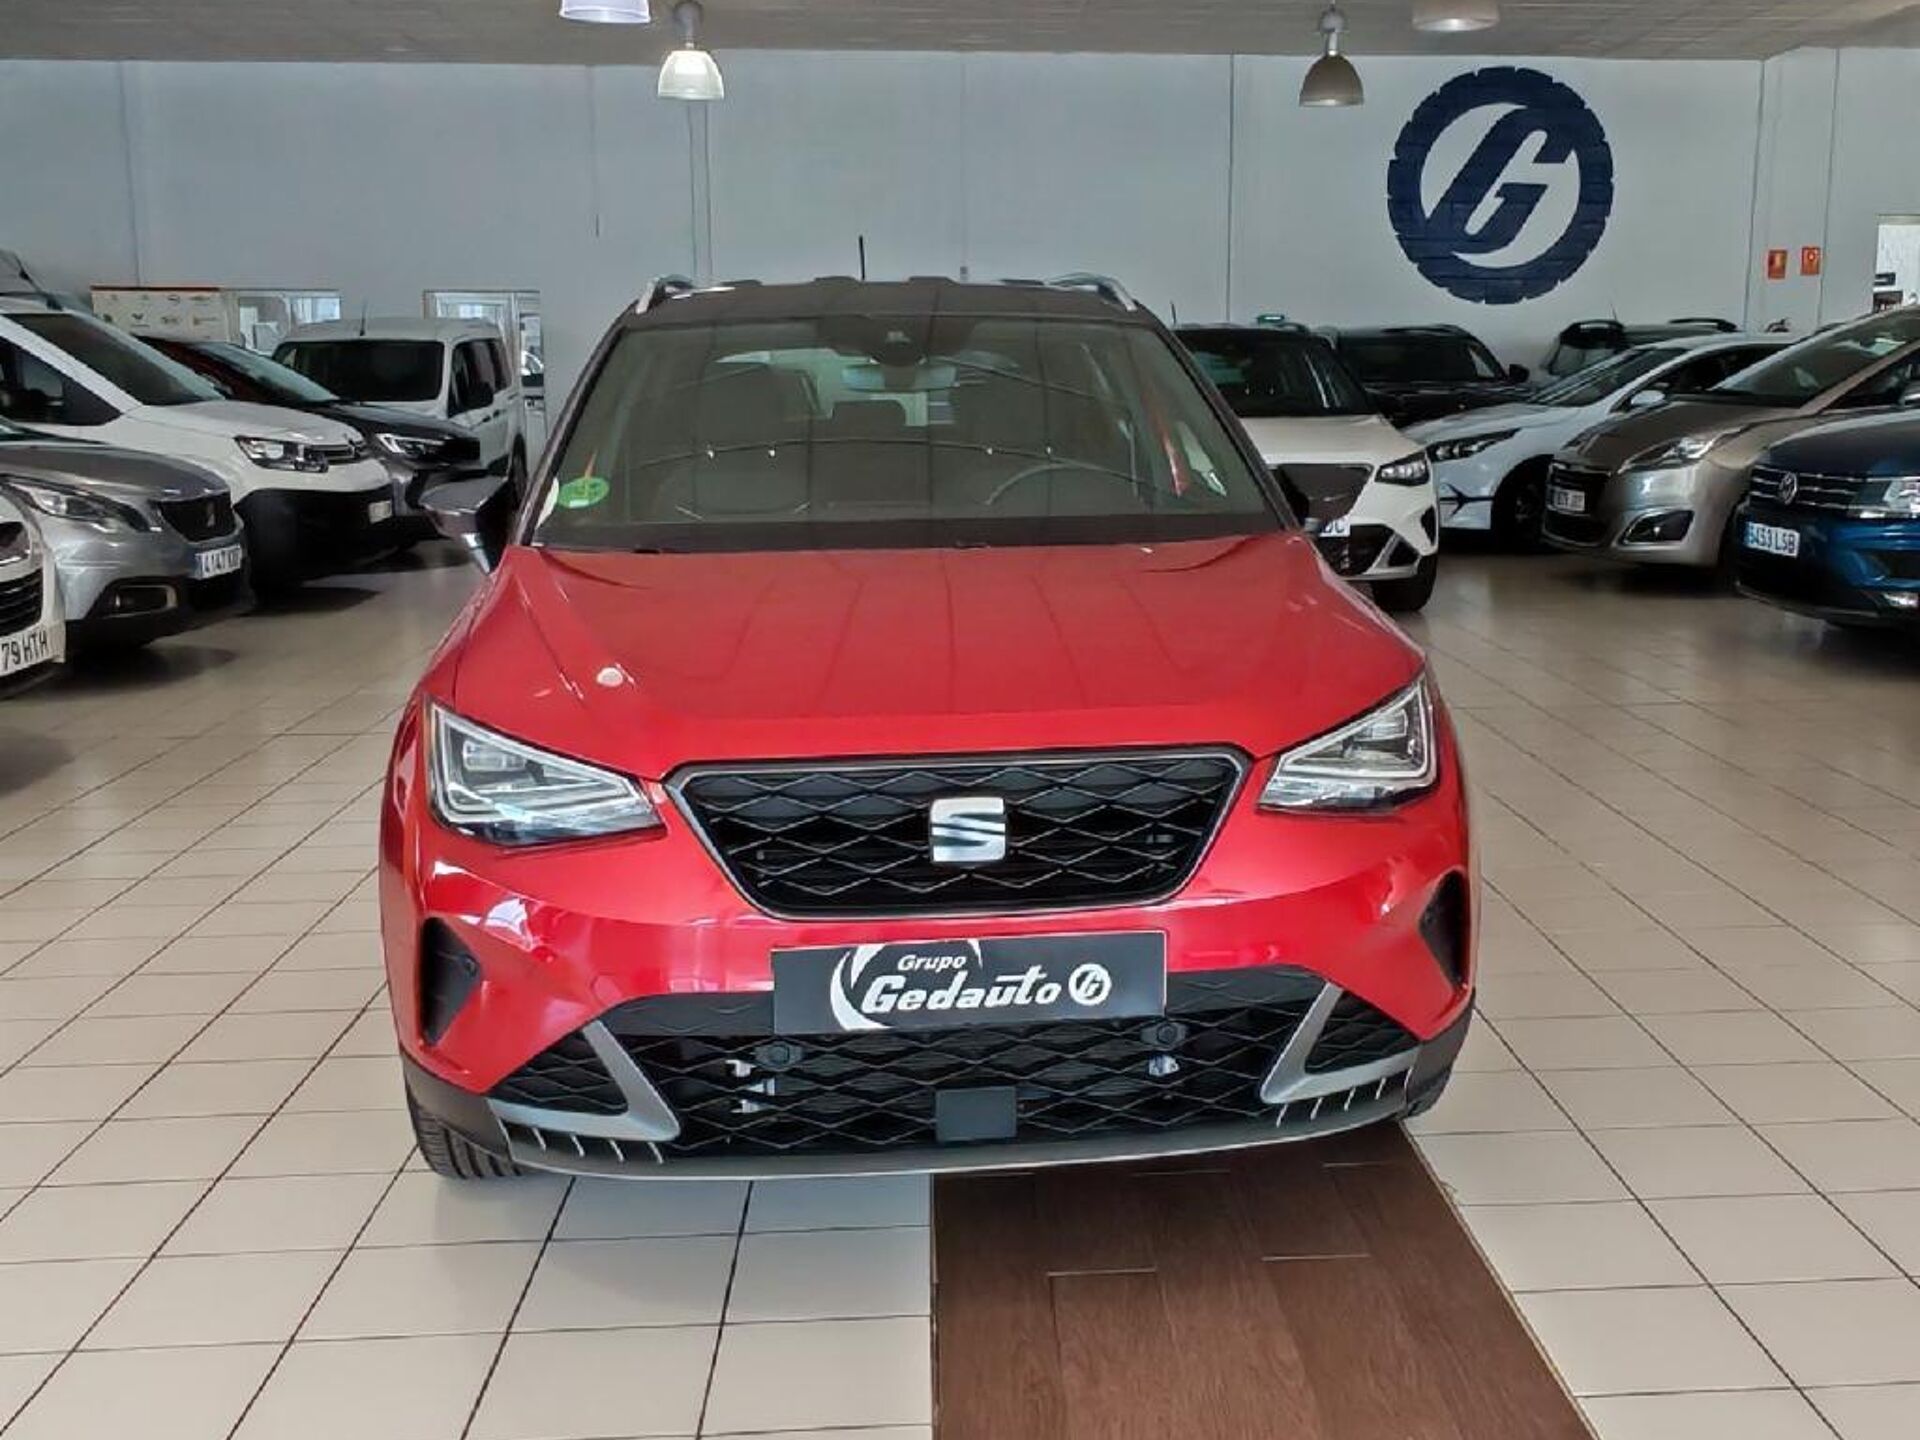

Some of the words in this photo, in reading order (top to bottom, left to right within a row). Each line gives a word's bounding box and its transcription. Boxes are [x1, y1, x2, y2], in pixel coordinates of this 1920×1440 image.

[1774, 530, 1796, 555] LSB
[22, 630, 48, 662] HTH
[897, 954, 967, 973] Grupo
[860, 965, 1062, 1015] Gedauto
